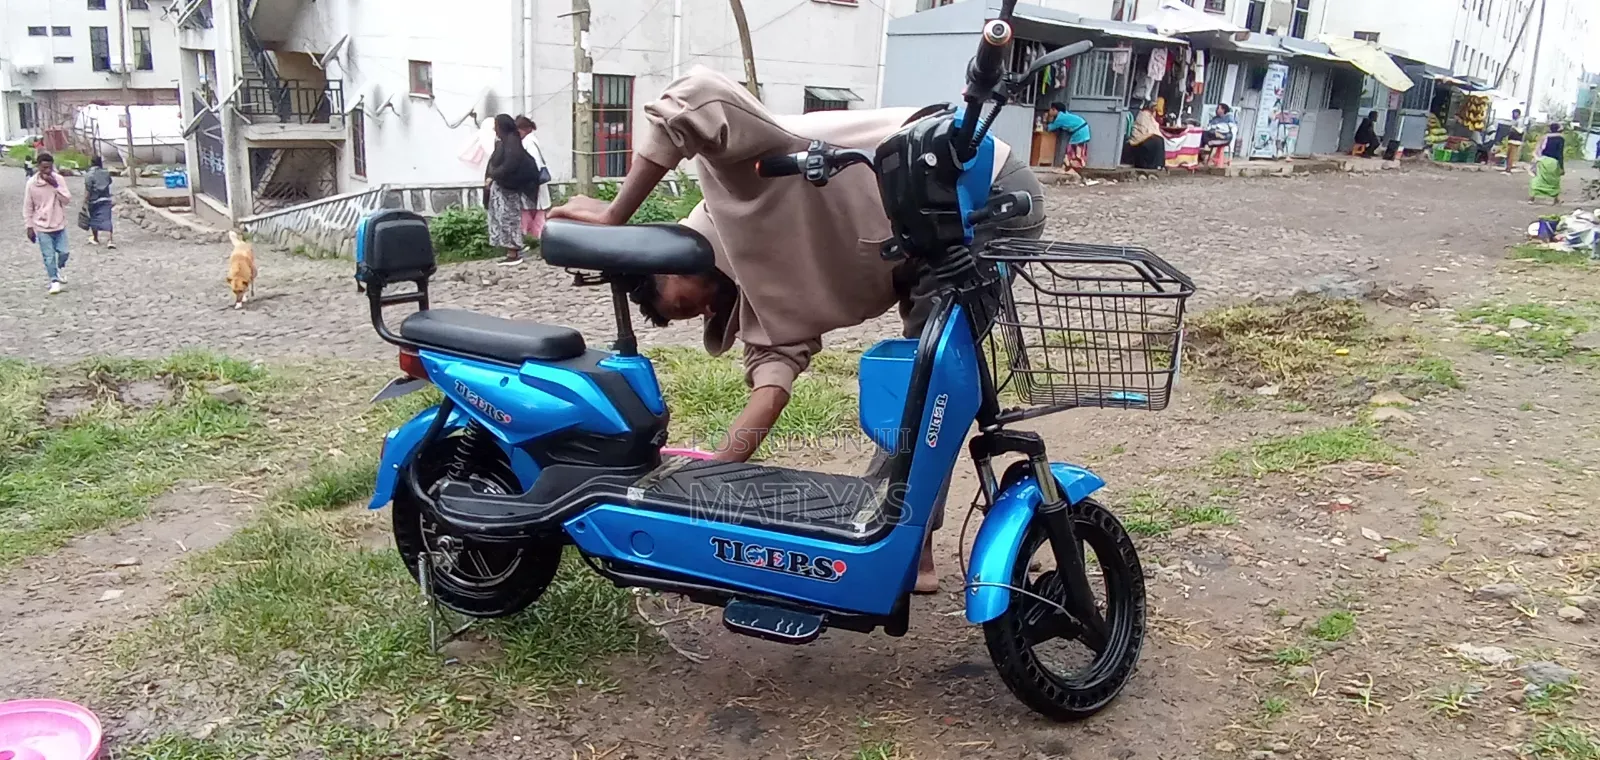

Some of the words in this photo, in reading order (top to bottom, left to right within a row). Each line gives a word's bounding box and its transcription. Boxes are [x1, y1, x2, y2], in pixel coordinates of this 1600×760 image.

[454, 379, 506, 423] TIGERS
[926, 394, 948, 446] TIGERS
[710, 536, 837, 581] TIGERS
